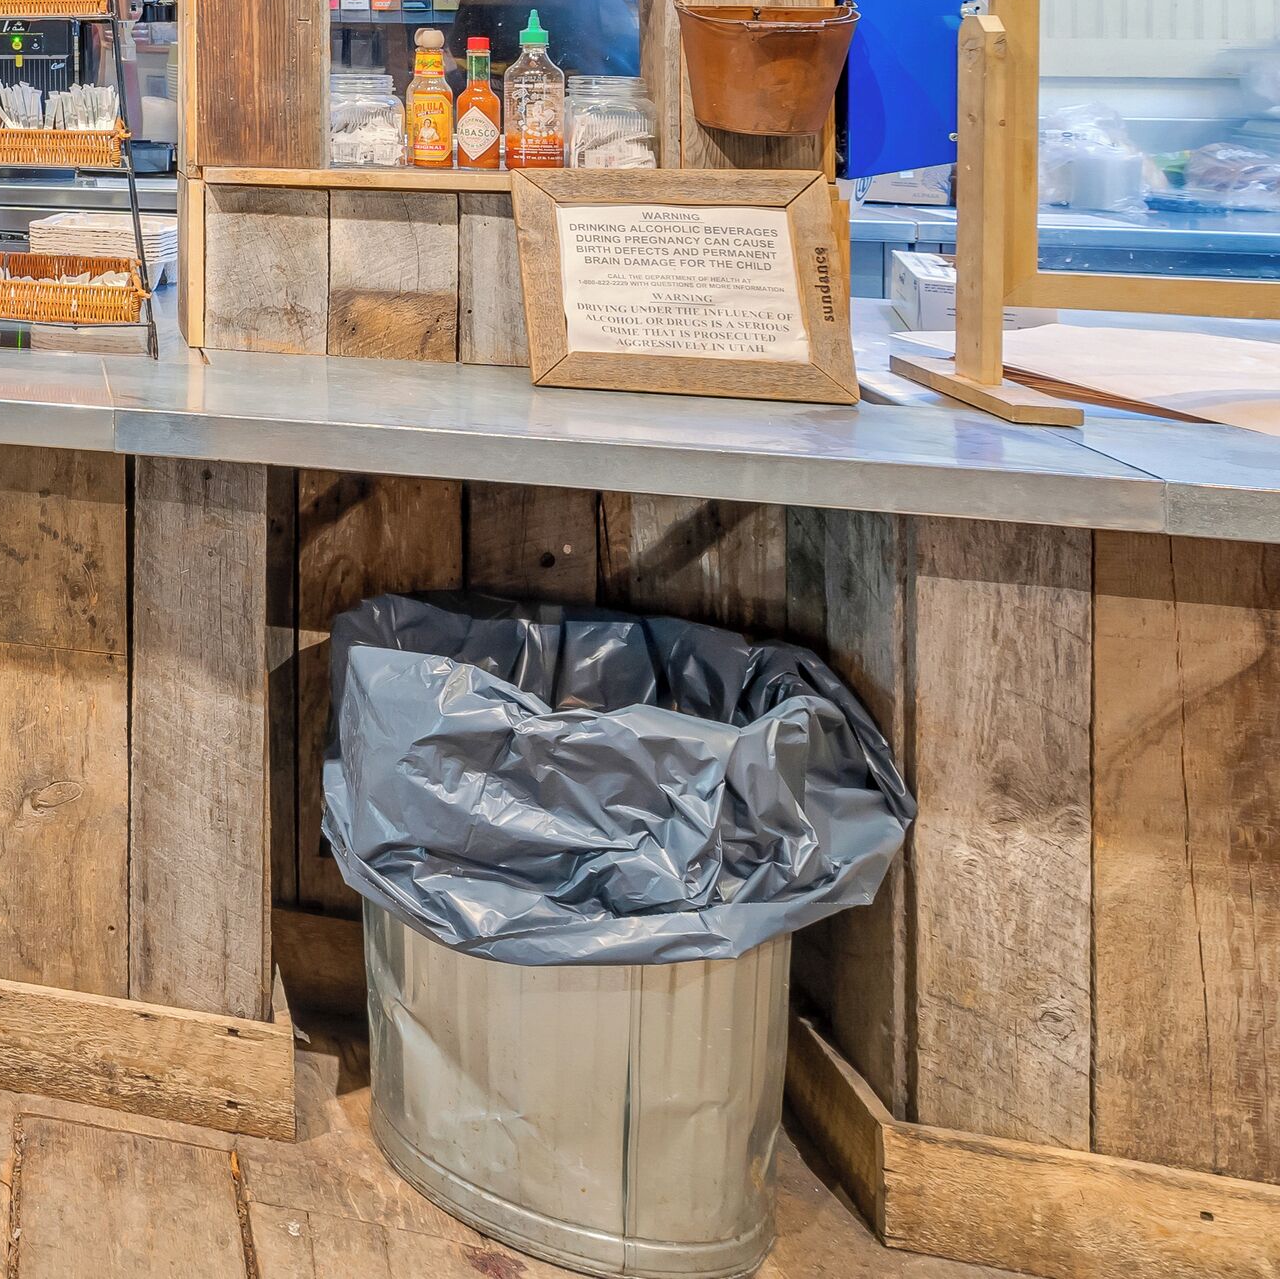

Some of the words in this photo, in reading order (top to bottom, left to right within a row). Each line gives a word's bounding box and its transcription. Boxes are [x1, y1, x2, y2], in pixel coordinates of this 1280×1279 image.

[458, 128, 496, 138] TABASCO
[642, 211, 700, 221] WARNING
[570, 224, 626, 233] DRINKING
[630, 224, 700, 234] ALCOHOLIC
[704, 227, 778, 237] BEVERAGES
[576, 234, 620, 243] DURING
[625, 236, 700, 245] PREGNANCY
[704, 237, 730, 246] CAN
[733, 239, 775, 249] CAUSE
[576, 246, 611, 254] BIRTH
[615, 247, 669, 255] DEFECTS
[673, 248, 699, 256] AND
[703, 249, 777, 260] PERMANENT
[585, 256, 620, 266] BRAIN
[624, 258, 676, 267] DAMAGE
[680, 259, 706, 268] FOR
[709, 260, 733, 269] THE
[737, 261, 771, 271] CHILD
[815, 247, 834, 322] sundance
[652, 292, 713, 303] WARNING
[577, 303, 627, 313] DRIVING
[631, 305, 670, 315] UNDER
[674, 307, 700, 316] THE
[704, 308, 773, 319] INFLUENCE
[777, 312, 794, 321] OF
[586, 314, 641, 325] ALCOHOL
[646, 317, 664, 325] OR
[667, 318, 707, 327] DRUGS
[726, 321, 734, 329] A
[738, 321, 790, 332] SERIOUS
[602, 325, 639, 336] CRIME
[643, 328, 676, 337] THAT
[694, 331, 776, 343] PROSECUTED
[617, 338, 708, 351] AGGRESSIVELY
[712, 343, 726, 351] IN
[730, 344, 765, 352] UTAH
